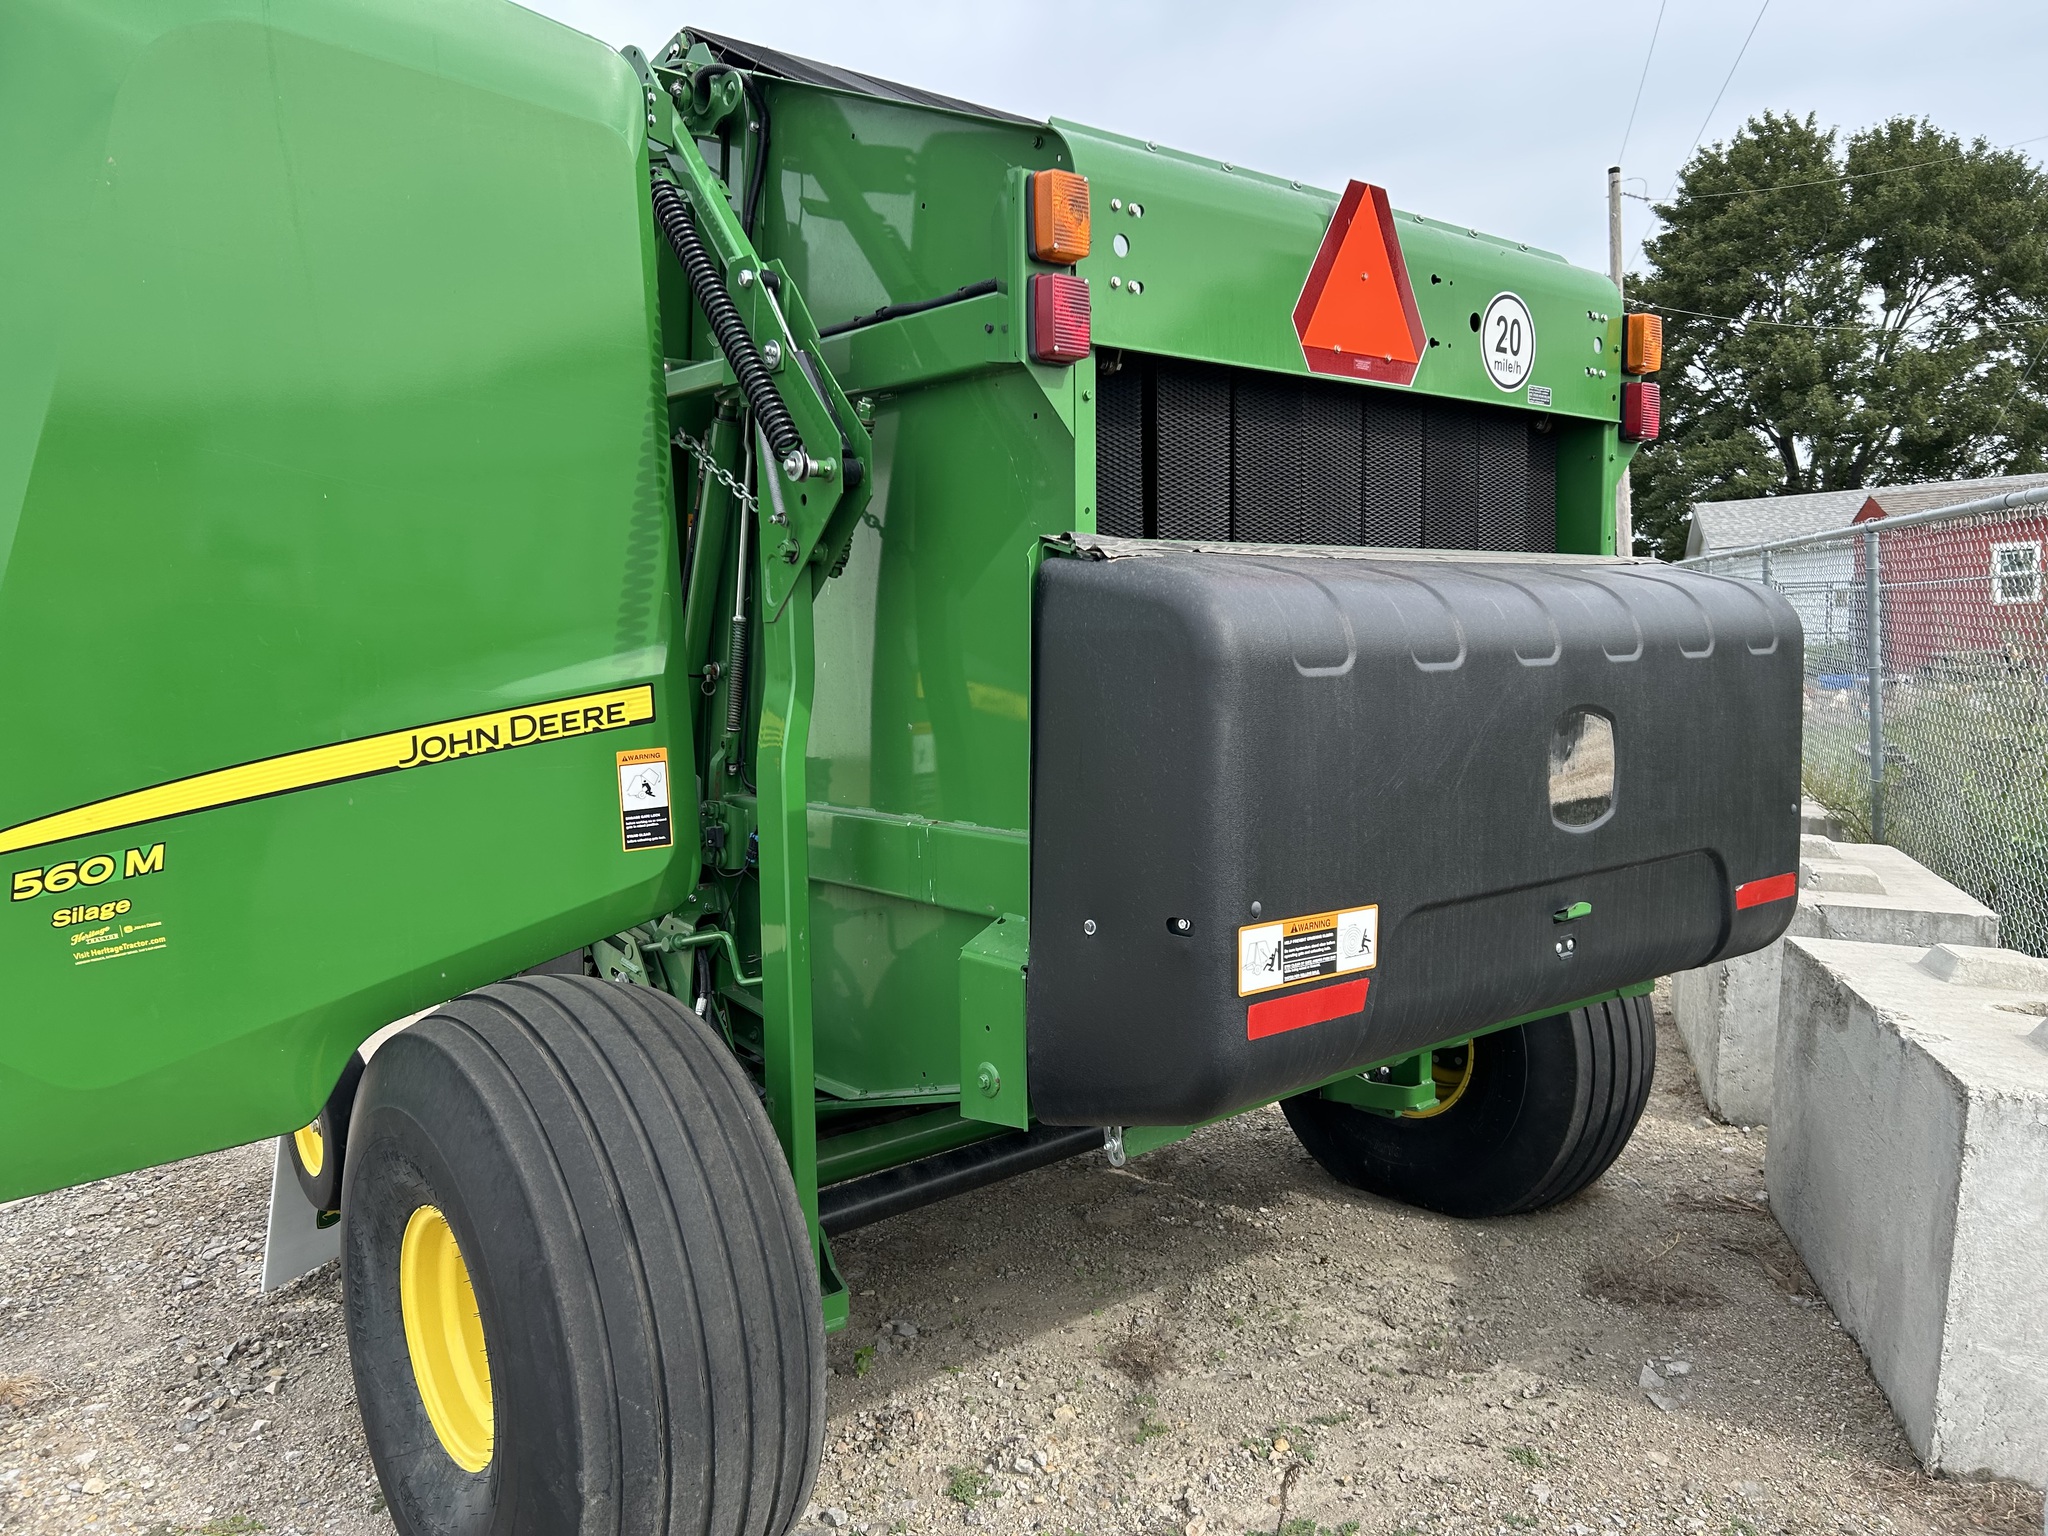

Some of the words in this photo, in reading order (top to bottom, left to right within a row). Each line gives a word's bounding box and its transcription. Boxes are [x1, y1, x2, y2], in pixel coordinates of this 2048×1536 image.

[1495, 315, 1521, 356] 20
[1494, 358, 1522, 375] mile/h
[399, 724, 500, 765] JOHN
[510, 702, 626, 741] DEERE
[628, 752, 661, 762] WARNING
[10, 854, 117, 902] 560
[124, 842, 166, 879] M
[51, 898, 132, 928] Silage
[1298, 919, 1330, 931] WARNING
[73, 950, 90, 960] Visit
[91, 936, 166, 957] HeritageTractor.com
